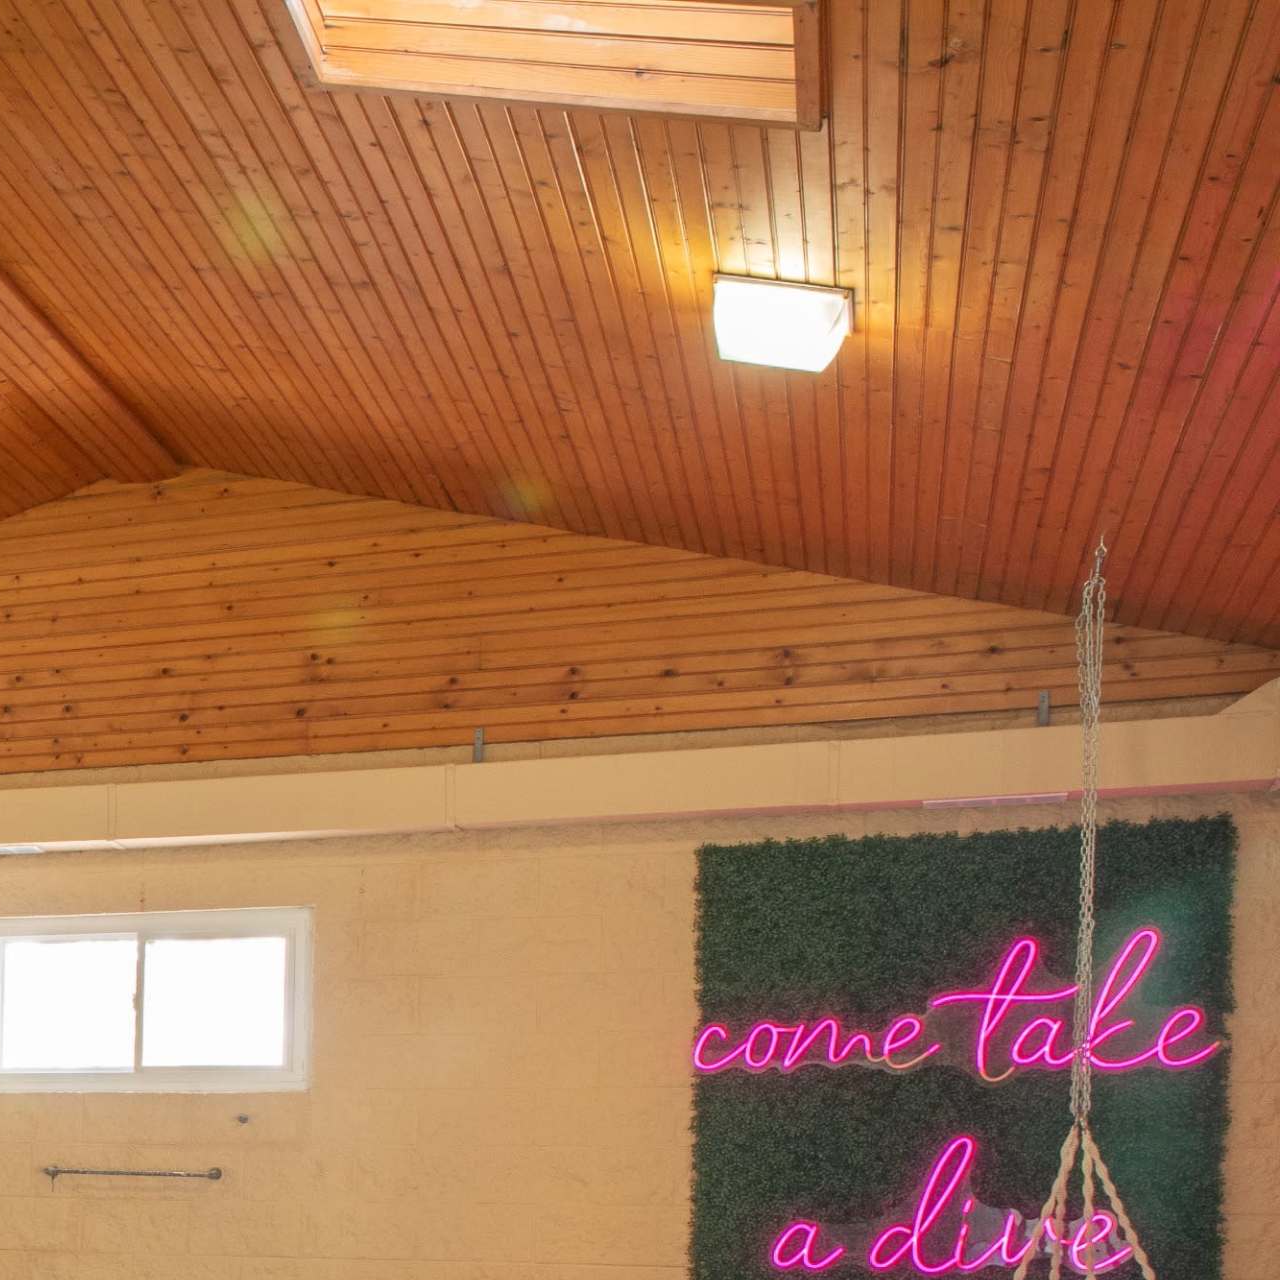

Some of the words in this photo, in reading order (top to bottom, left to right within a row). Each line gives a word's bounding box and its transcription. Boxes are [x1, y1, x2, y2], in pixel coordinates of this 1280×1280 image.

[692, 1012, 941, 1072] come
[930, 927, 1223, 1083] take
[771, 1219, 845, 1271] a
[868, 1136, 1135, 1277] dive
